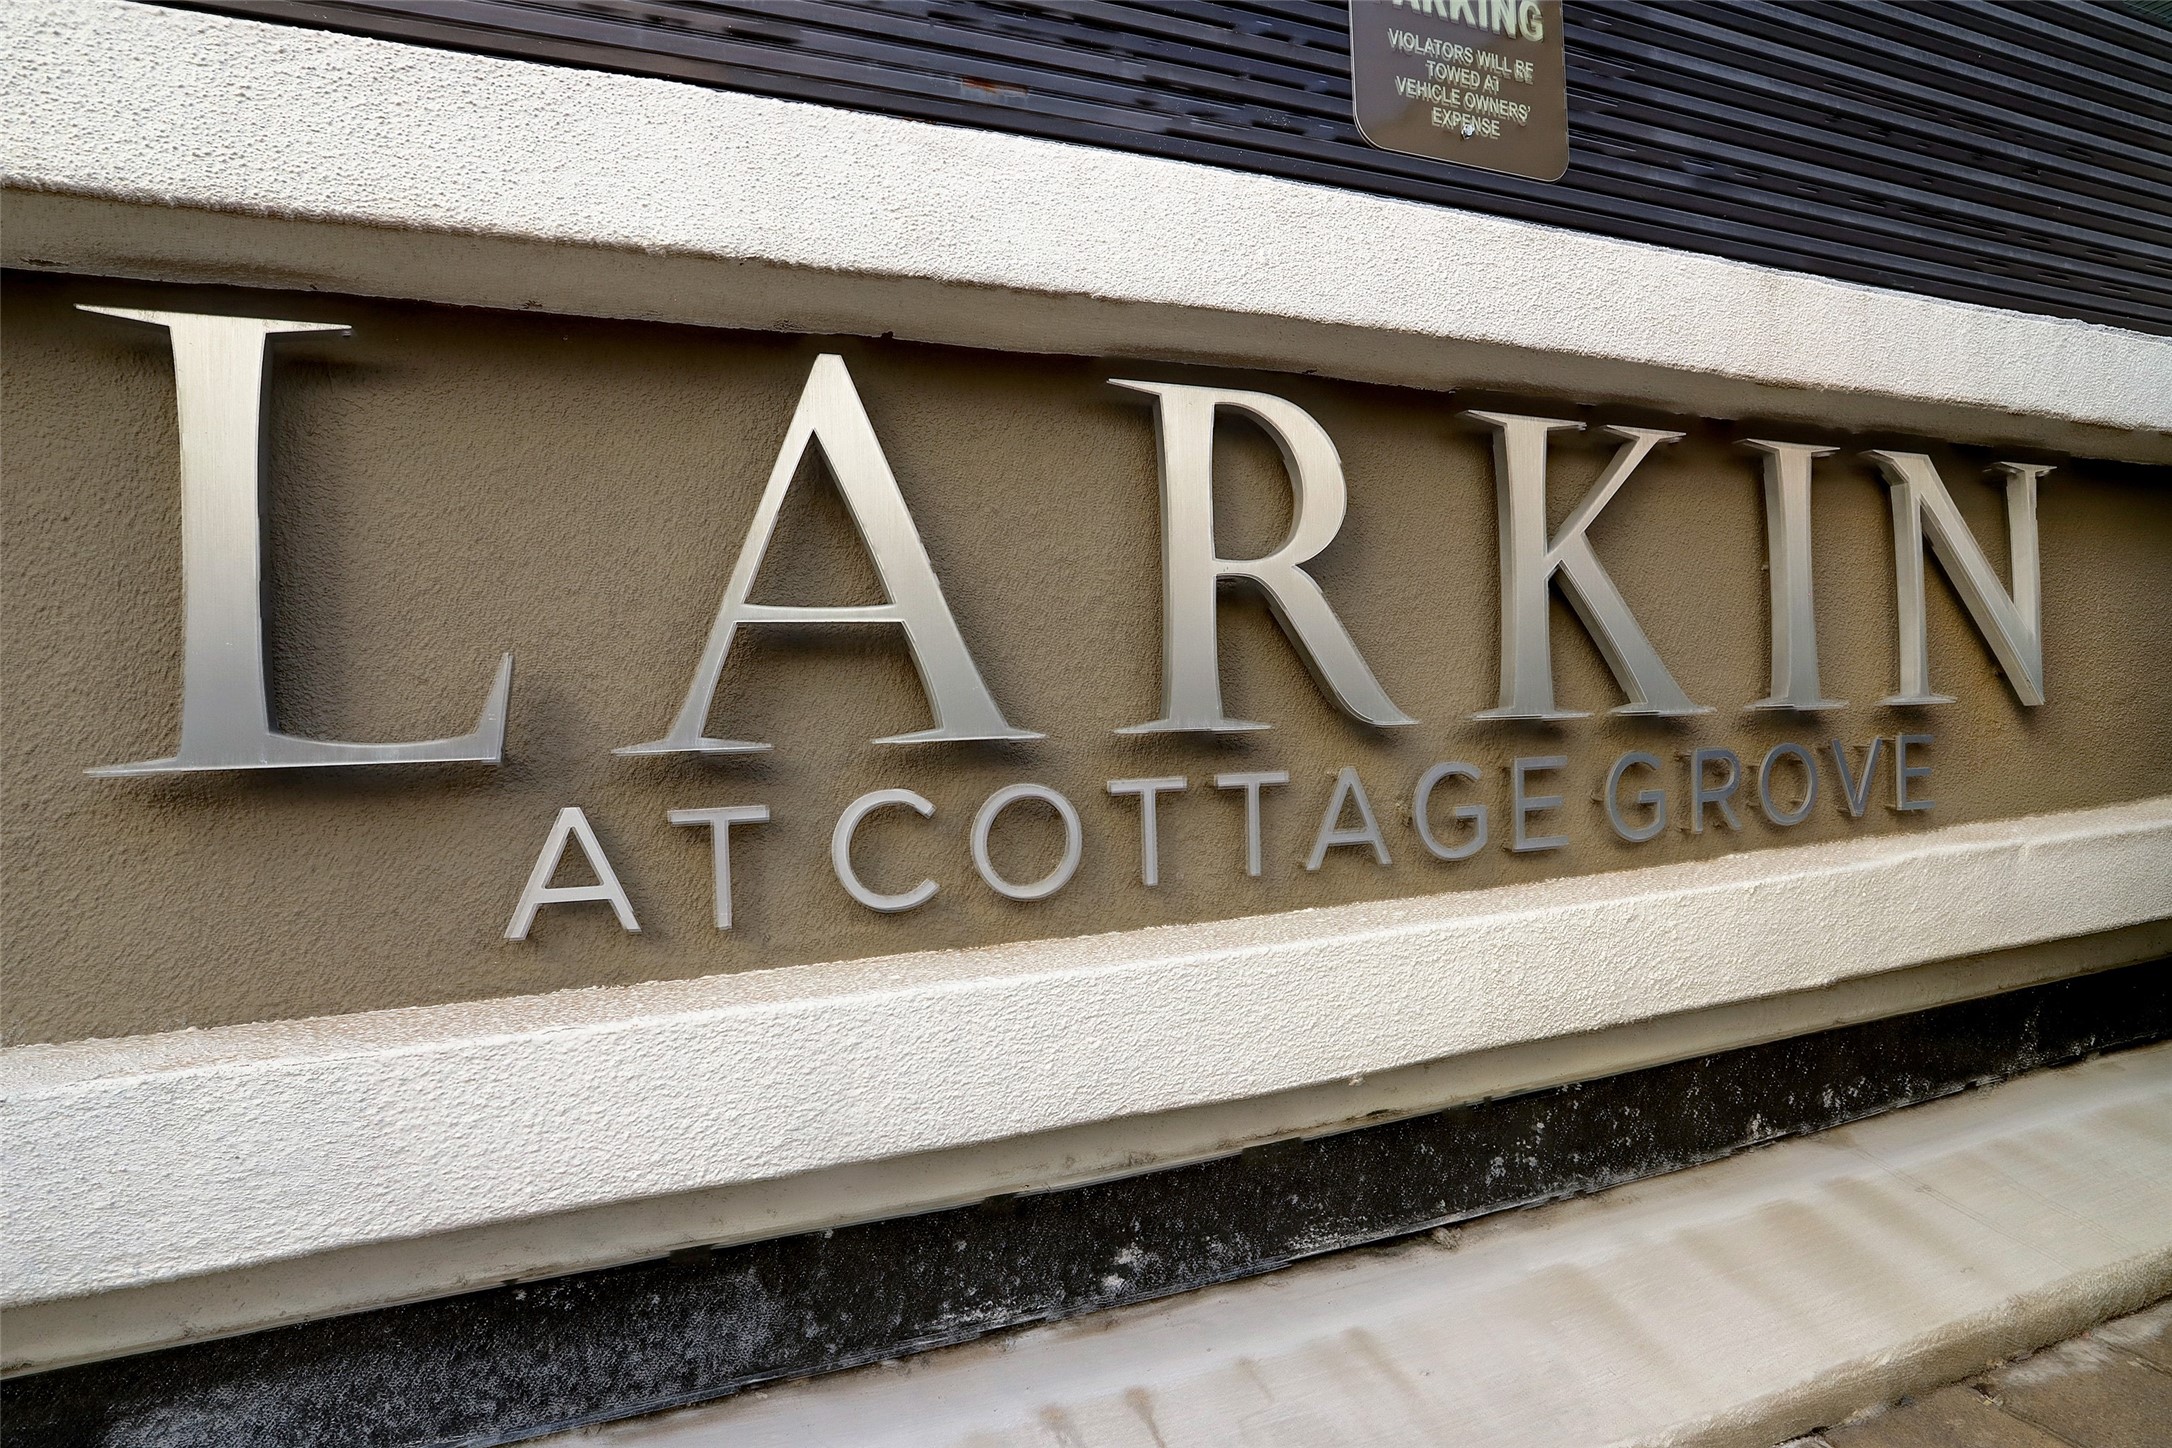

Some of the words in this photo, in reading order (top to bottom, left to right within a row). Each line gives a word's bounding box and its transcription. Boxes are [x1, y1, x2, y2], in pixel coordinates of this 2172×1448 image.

[1390, 0, 1544, 42] KING
[1388, 27, 1474, 64] VIOLATORS
[1476, 49, 1512, 74] WILL
[1514, 58, 1534, 80] BE
[1426, 59, 1481, 89] TOWED
[1483, 74, 1500, 92] AT
[1395, 75, 1460, 106] VEHICLE
[1463, 91, 1531, 122] OWNERS'
[1432, 106, 1500, 137] EXPENSE
[75, 303, 2056, 777] LARKIN
[502, 805, 771, 941] AT
[830, 754, 1570, 914] COTTAGE
[1602, 732, 1935, 843] GROVE
